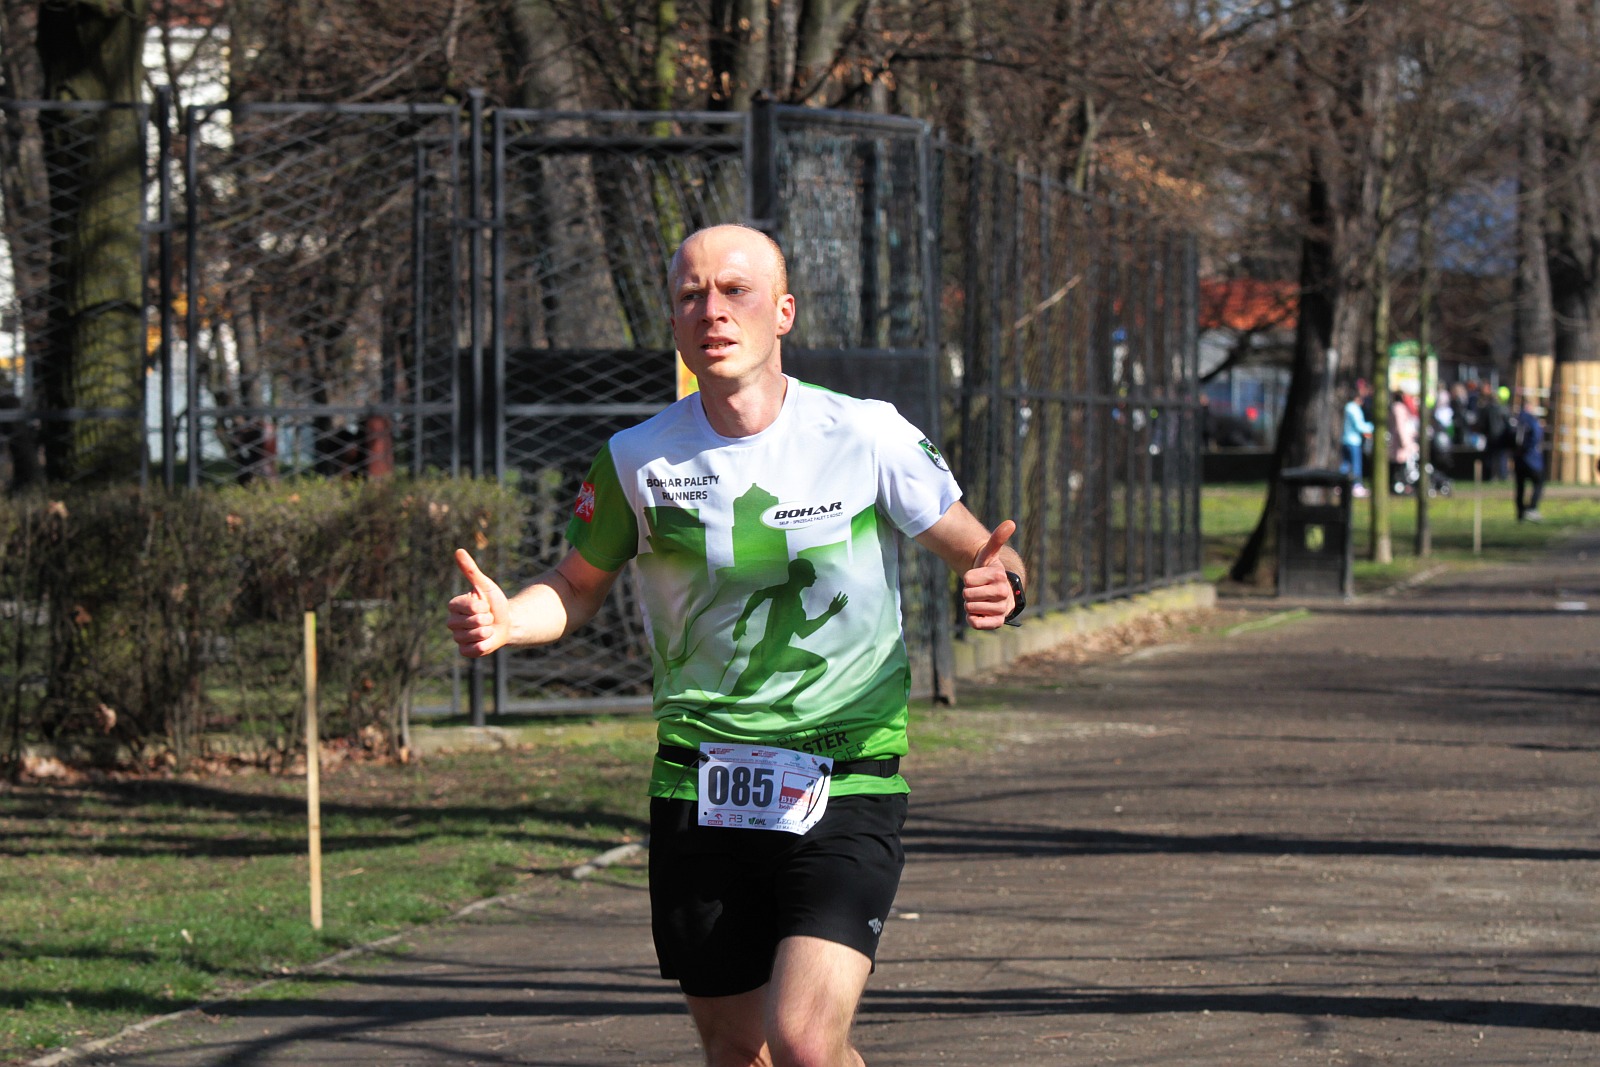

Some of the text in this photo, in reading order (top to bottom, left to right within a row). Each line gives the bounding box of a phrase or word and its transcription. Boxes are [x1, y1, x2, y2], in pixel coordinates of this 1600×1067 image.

[646, 475, 720, 487] BOHAR PALETY
[662, 490, 708, 500] RUNNERS
[774, 501, 842, 520] BOHAR
[708, 765, 775, 808] 085
